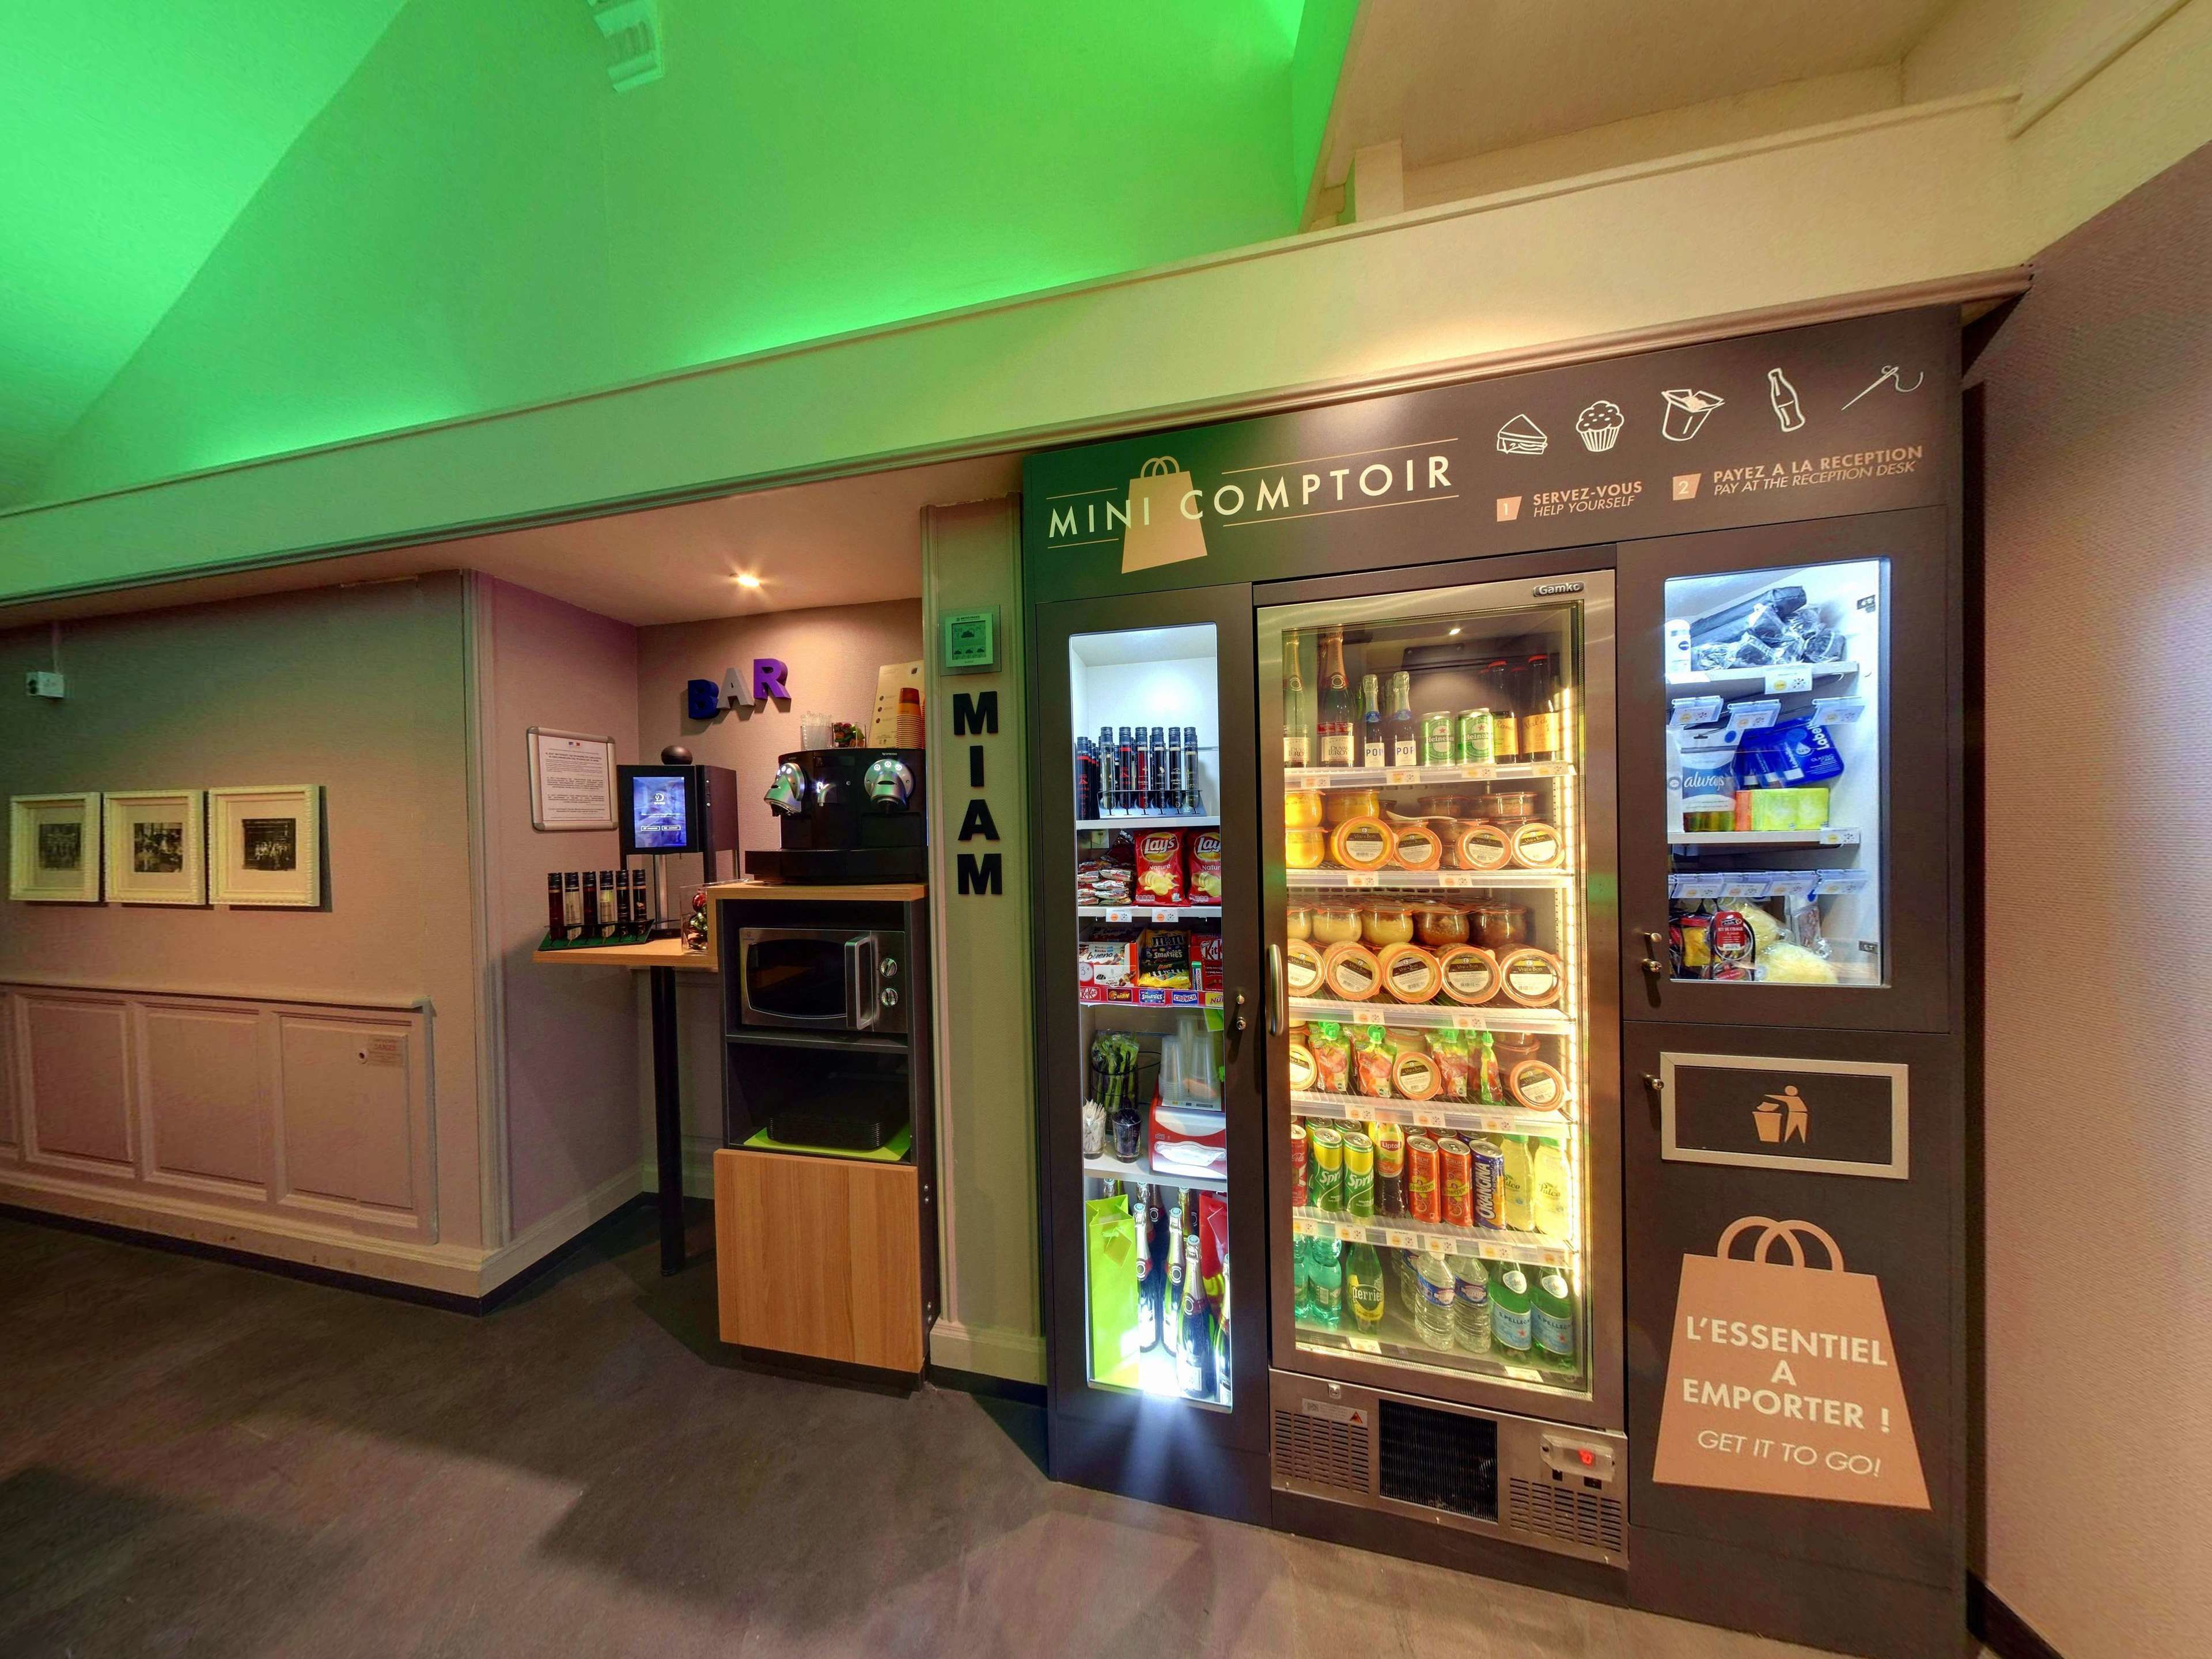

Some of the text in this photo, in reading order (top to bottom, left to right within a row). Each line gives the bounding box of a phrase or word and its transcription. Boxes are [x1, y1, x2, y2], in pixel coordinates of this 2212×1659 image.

[1713, 445, 1923, 483] PAYEZ A LA RECEPTION
[1714, 460, 1917, 495] PAY AT THE RECEPTION DESK
[1048, 455, 1453, 538] MINI COMPTOIR
[1532, 480, 1642, 506] SERVEZ-VOUS
[1533, 495, 1635, 517] HELP YOURSELF
[1678, 480, 1690, 495] 2
[1502, 503, 1509, 516] 1
[687, 658, 792, 720] BAR
[953, 691, 1003, 896] MIAM
[1684, 771, 1725, 791] always
[1475, 1162, 1497, 1219] ORANGINA
[1686, 1316, 1888, 1366] L'ESSENTIEL
[1770, 1359, 1797, 1387] A
[1682, 1378, 1890, 1433] EMPORTER !
[1698, 1429, 1882, 1478] GET IT TO GO!
